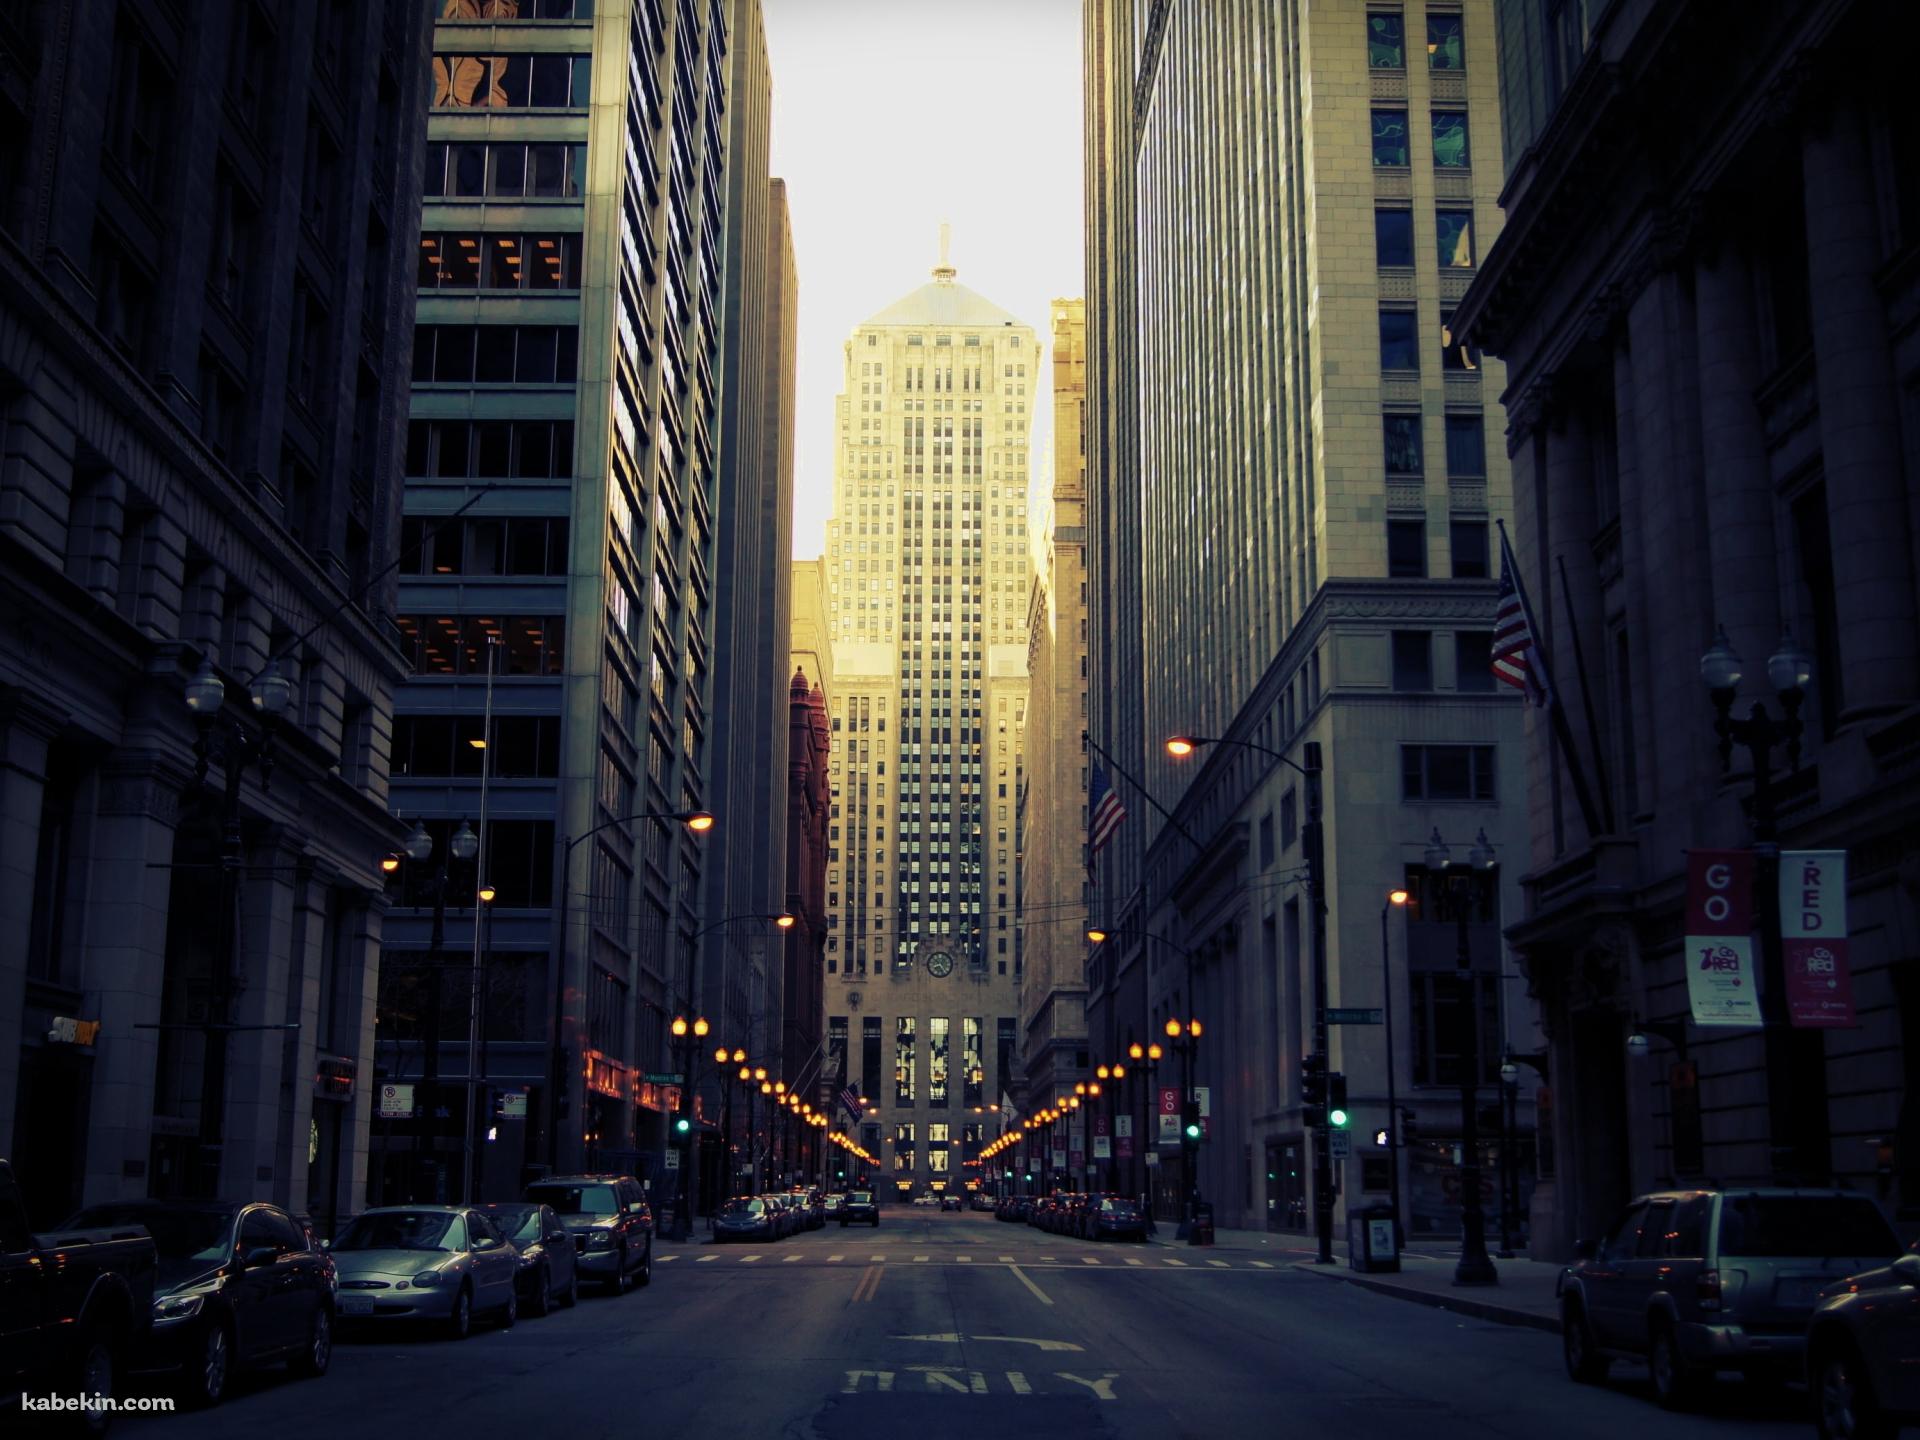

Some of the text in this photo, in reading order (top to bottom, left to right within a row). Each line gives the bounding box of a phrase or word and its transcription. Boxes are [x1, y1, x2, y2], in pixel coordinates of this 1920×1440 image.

[1704, 863, 1731, 922] GO
[1802, 867, 1822, 931] RED
[1165, 1091, 1175, 1111] GO
[1441, 1175, 1494, 1202] CS
